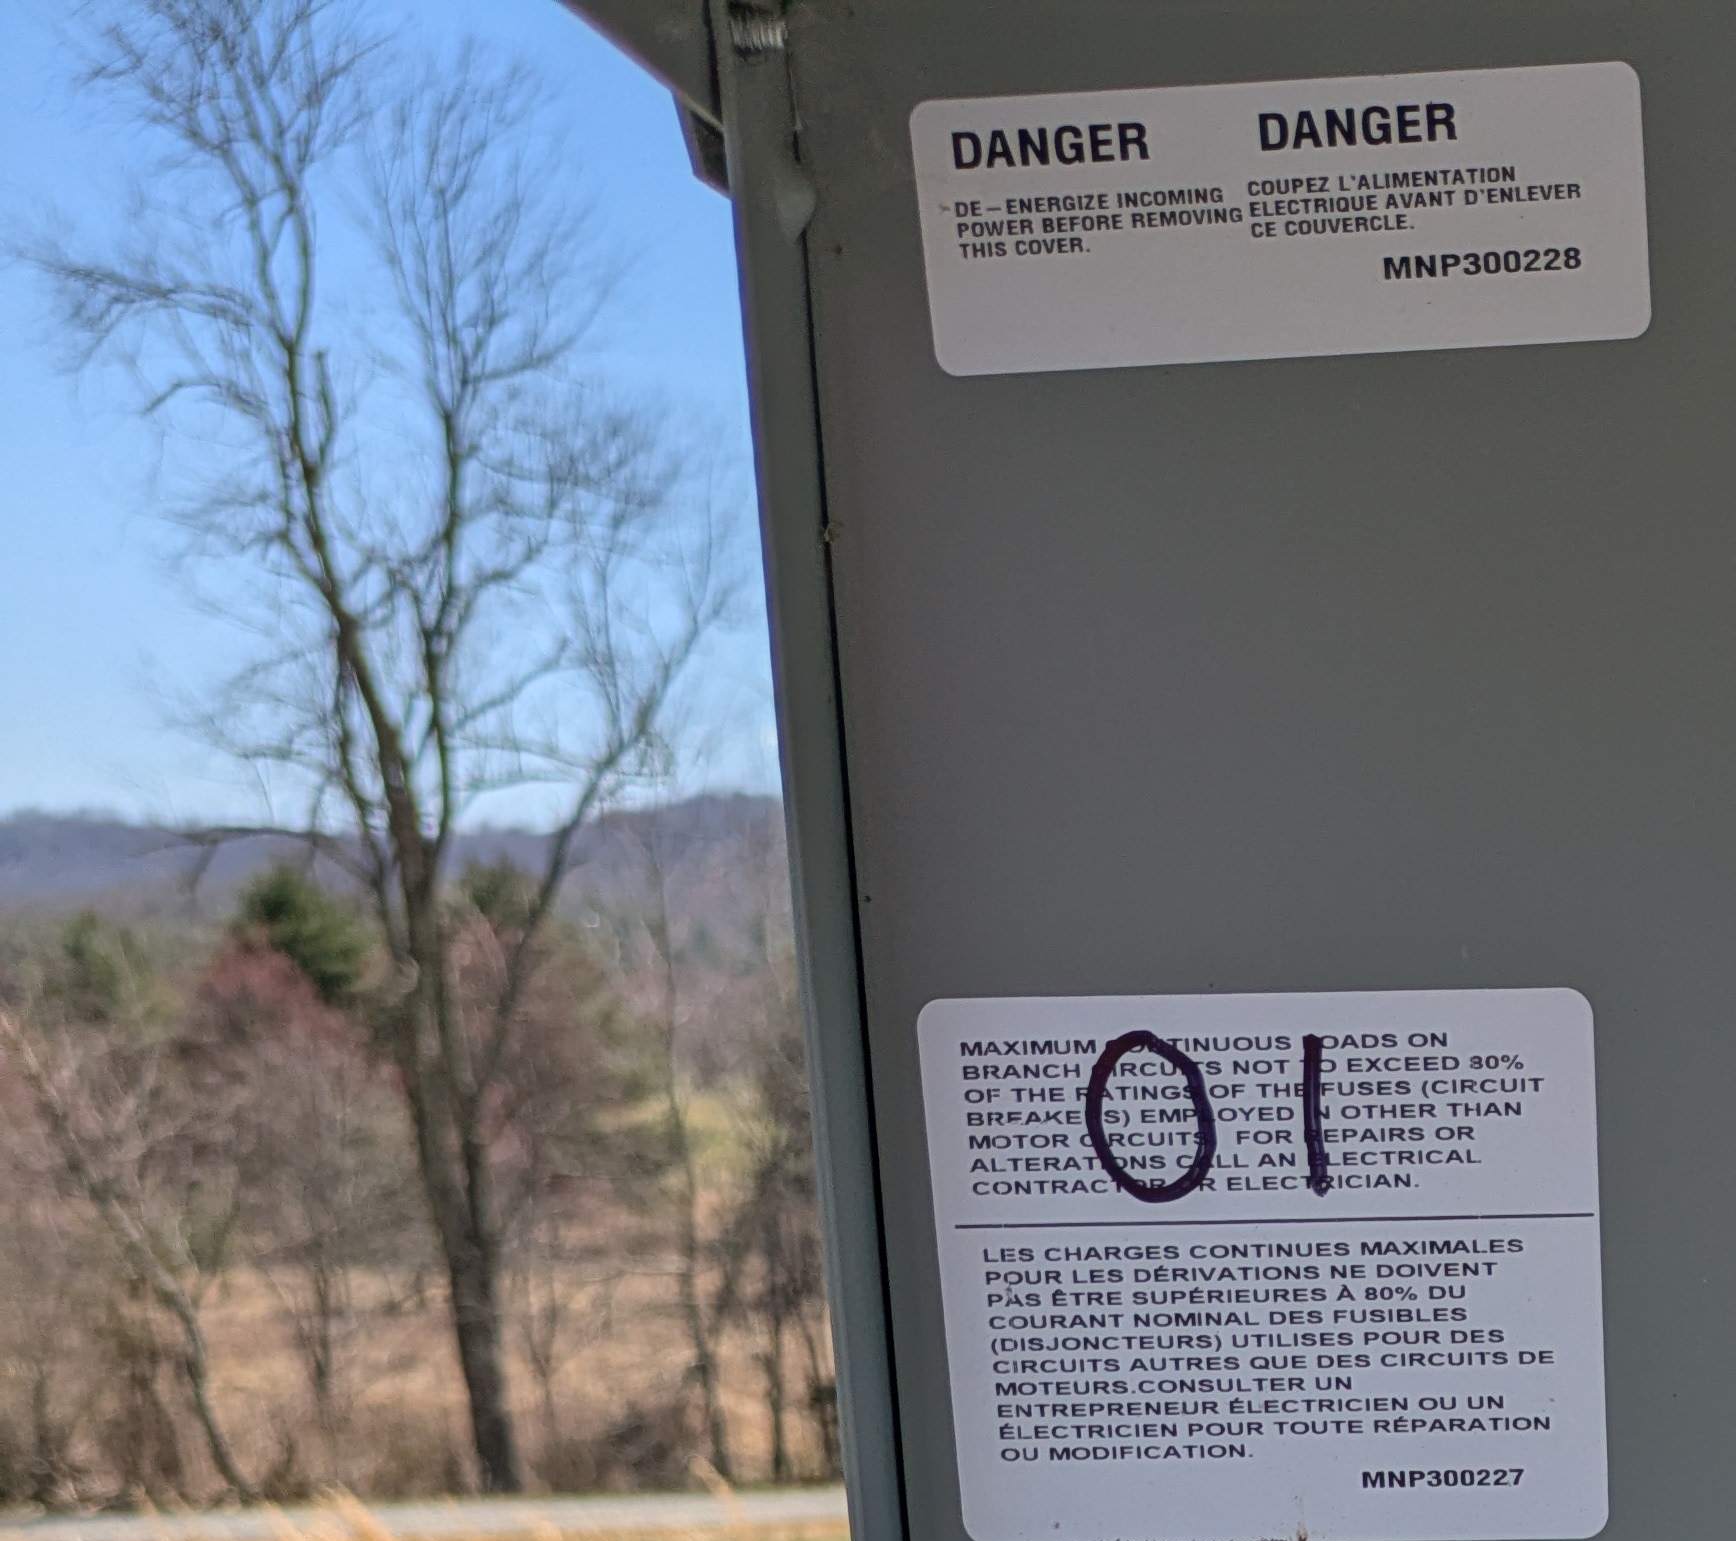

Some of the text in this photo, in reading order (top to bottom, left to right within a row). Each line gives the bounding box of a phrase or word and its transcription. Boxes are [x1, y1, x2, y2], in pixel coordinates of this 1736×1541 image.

[1258, 101, 1457, 151] DANGER
[951, 122, 1149, 169] DANGER
[1248, 166, 1515, 196] COUPEZ L'ALIMENTATION
[1117, 188, 1223, 208] INCOMING
[1249, 184, 1580, 217] ELECTRIQUE AVANT D'ENLEVER
[957, 208, 1243, 238] POWER BEFORE REMOVING
[1251, 214, 1414, 238] CE COUVERCLE.
[959, 237, 1090, 258] THIS COVER.
[1383, 247, 1581, 280] MNP300228
[960, 1033, 1448, 1056] MAXIMUM ON
[963, 1064, 1080, 1080] BRANCH
[1233, 1060, 1290, 1074] NOT
[1347, 1056, 1460, 1072] EXCEED
[1011, 1078, 1544, 1102] THE FUSES (CIRCUIT
[1341, 1102, 1522, 1119] OTHER THAN
[968, 1126, 1474, 1149] MOTOR FOR OR
[983, 1239, 1523, 1262] LES CHARGES CONTINUES MAXIMALES
[986, 1262, 1497, 1285] POUR LES DÉRIVATIONS NE DOIVENT
[989, 1308, 1467, 1329] COURANT NOMINAL DES FUSIBLES
[991, 1335, 1221, 1355] (DISJONCTEURS)
[1364, 1331, 1441, 1345] POUR
[1451, 1330, 1504, 1344] DES
[1315, 1376, 1352, 1390] UN
[997, 1396, 1504, 1418] ENTREPRENEUR ÉLECTRICIEN OU UN
[999, 1416, 1550, 1439] ÉLECTRICIEN POUR TOUTE RÉPARATION
[1001, 1444, 1254, 1461] OU MODIFICATION.
[1362, 1469, 1524, 1488] MNP300227
